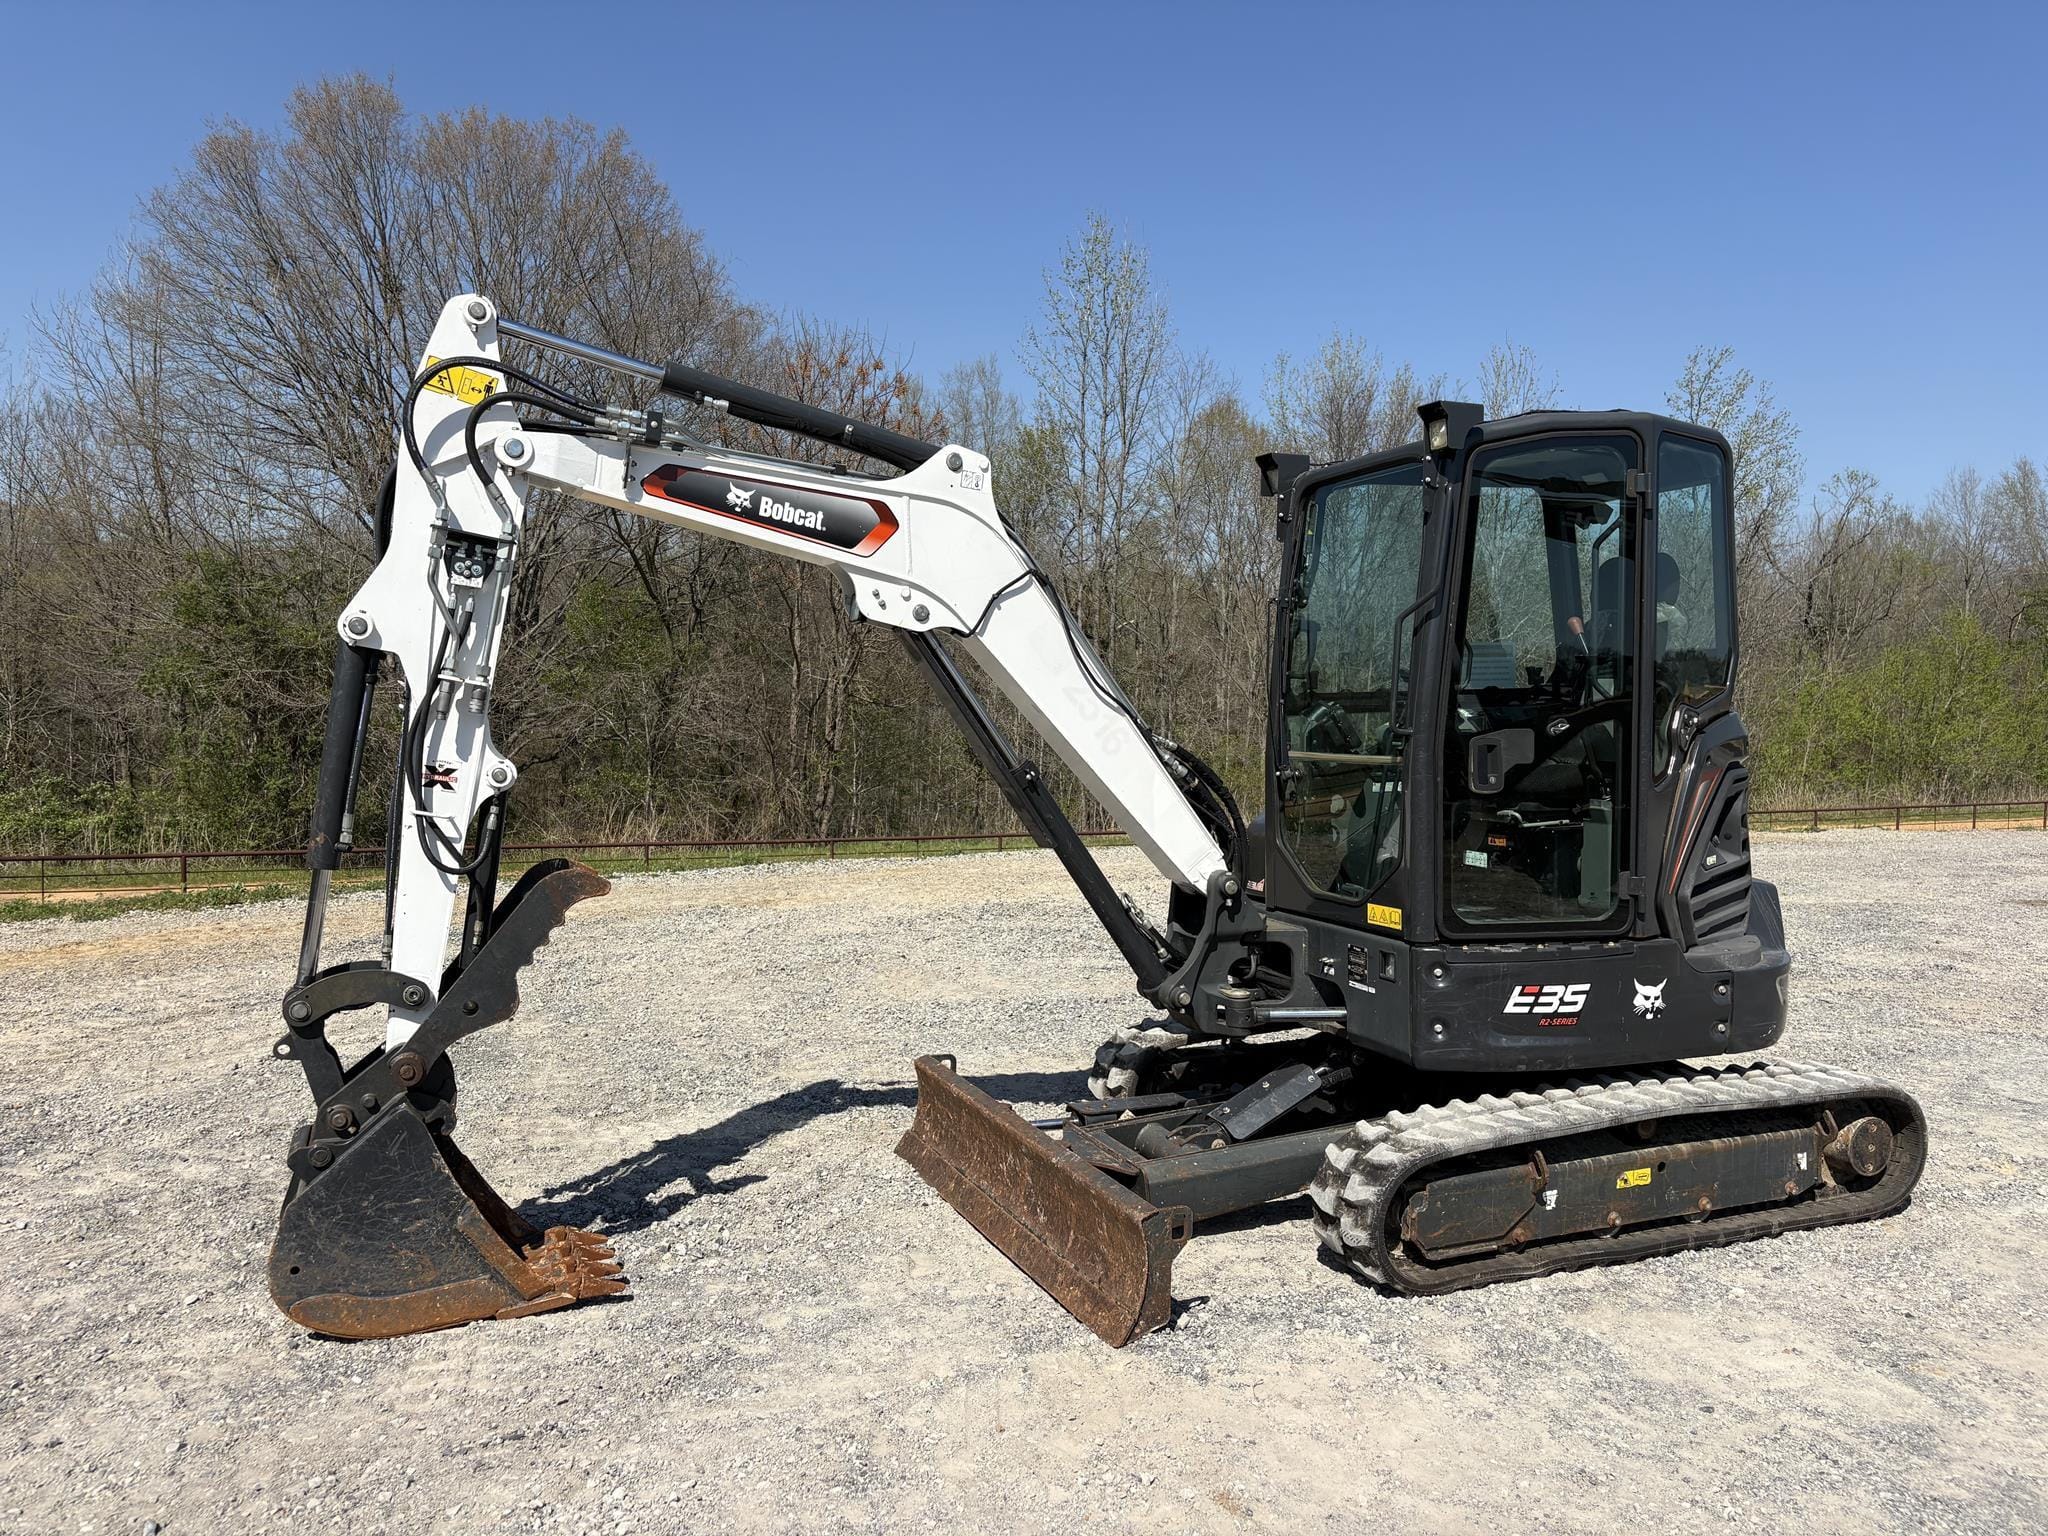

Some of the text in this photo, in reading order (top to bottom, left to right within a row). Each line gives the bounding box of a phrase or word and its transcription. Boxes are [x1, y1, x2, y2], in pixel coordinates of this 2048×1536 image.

[759, 496, 825, 530] Bobcat
[1502, 983, 1591, 1014] E35
[1539, 1016, 1578, 1026] R2-SERIES
